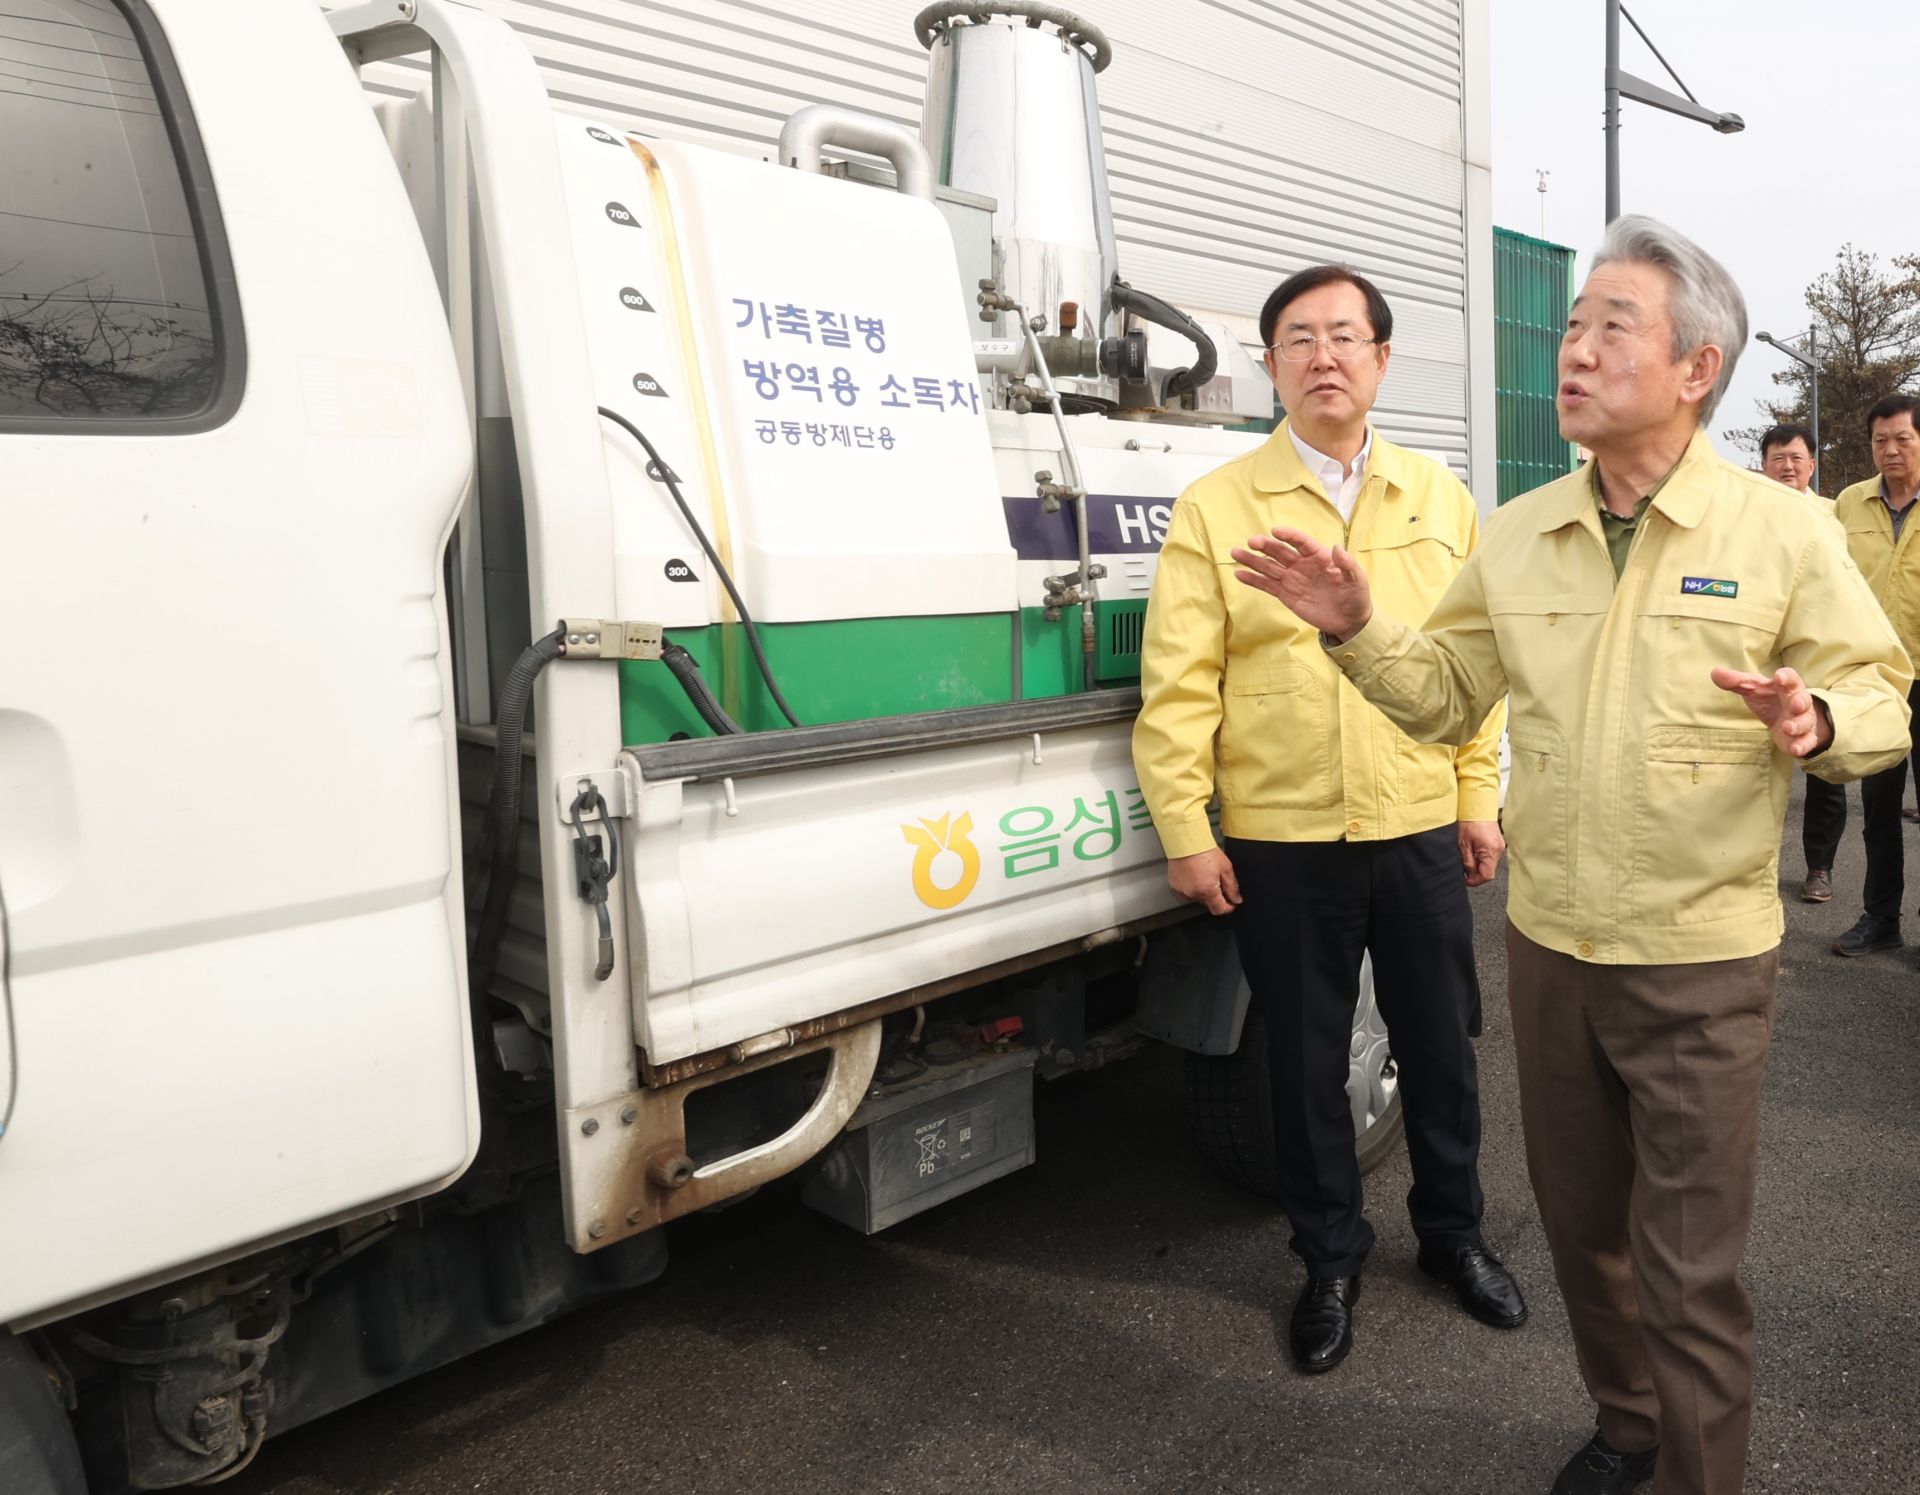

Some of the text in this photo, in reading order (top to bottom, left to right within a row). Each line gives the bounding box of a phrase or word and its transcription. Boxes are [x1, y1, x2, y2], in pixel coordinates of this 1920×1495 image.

[609, 209, 629, 220] 700
[623, 294, 643, 305] 600
[732, 298, 886, 354] 가축질병
[637, 380, 656, 391] 500
[743, 359, 979, 415] 방역용 소독차
[754, 419, 896, 451] 공동방제단용
[668, 567, 688, 576] 300
[1684, 580, 1702, 589] NH
[919, 1161, 935, 1178] Pb
